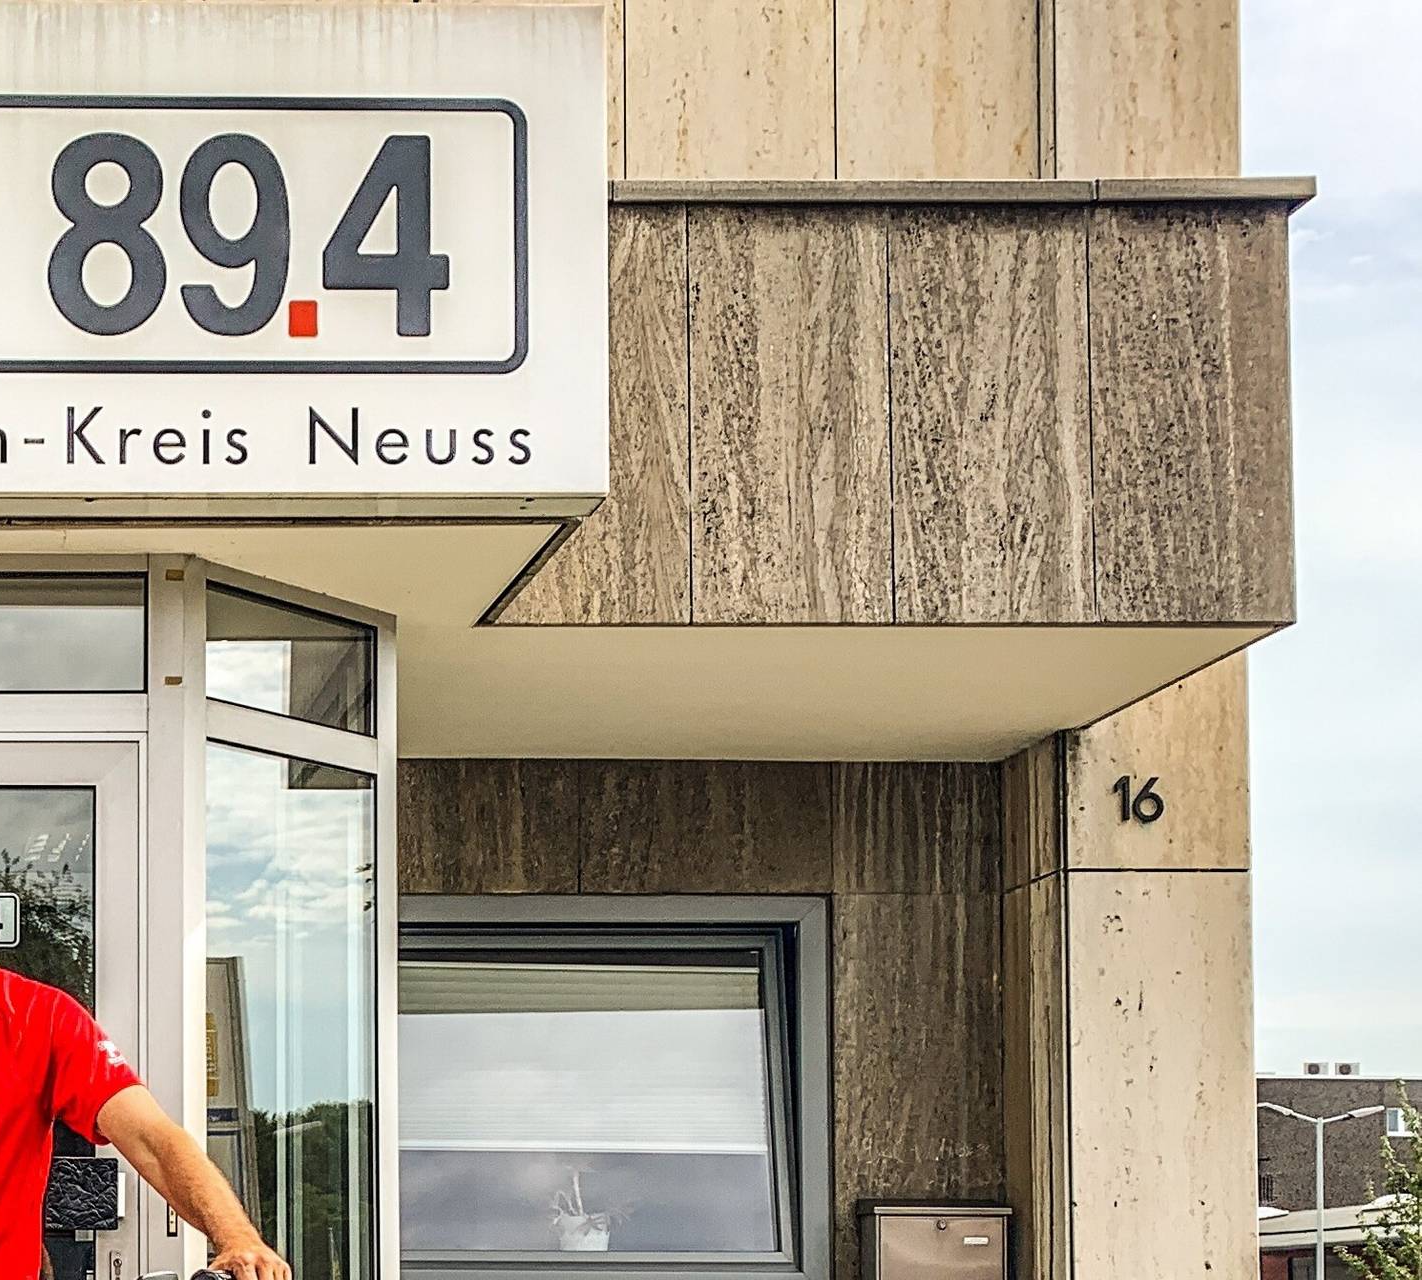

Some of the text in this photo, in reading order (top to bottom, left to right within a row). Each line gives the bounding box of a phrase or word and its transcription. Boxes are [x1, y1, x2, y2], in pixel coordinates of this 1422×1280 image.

[48, 131, 450, 338] 89.4
[307, 407, 532, 466] Neuss
[1112, 774, 1165, 824] 16
